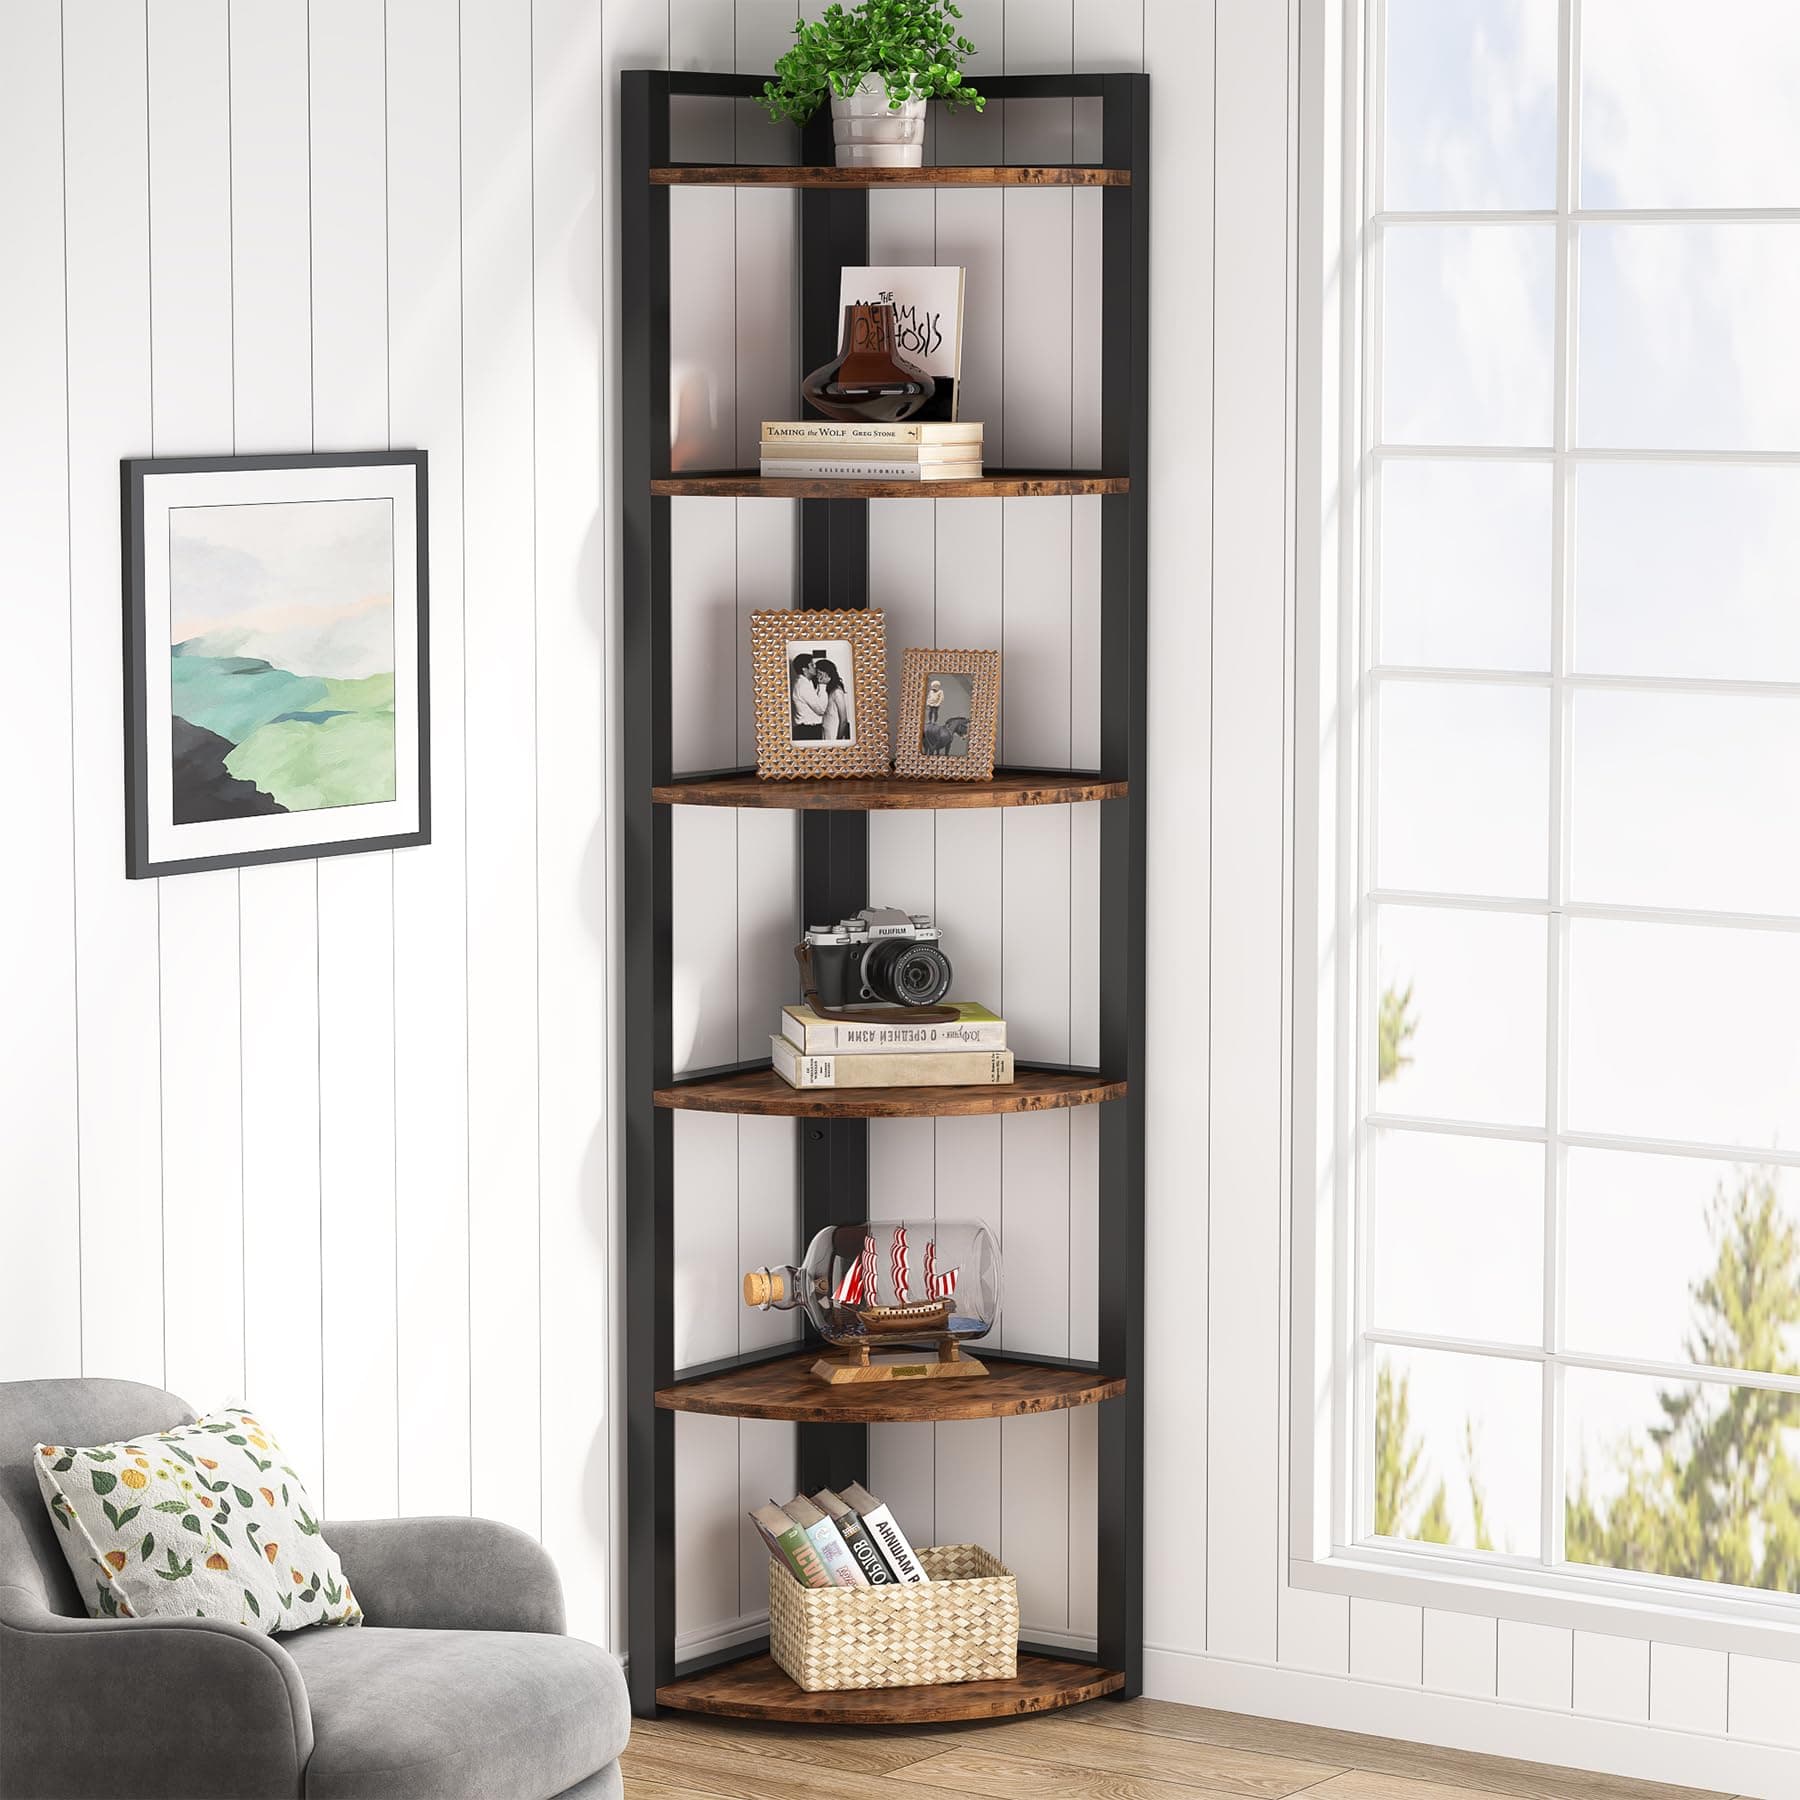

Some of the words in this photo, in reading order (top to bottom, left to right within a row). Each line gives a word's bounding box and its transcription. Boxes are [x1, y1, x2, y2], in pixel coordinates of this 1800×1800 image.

[879, 291, 893, 303] THE
[766, 426, 805, 436] TAMING
[819, 427, 847, 437] WOLF
[852, 429, 872, 437] GREG
[879, 928, 906, 936] FUJIFILM
[847, 1030, 876, 1042] АЗИИ
[880, 1029, 927, 1045] СРЕДНЕЙ
